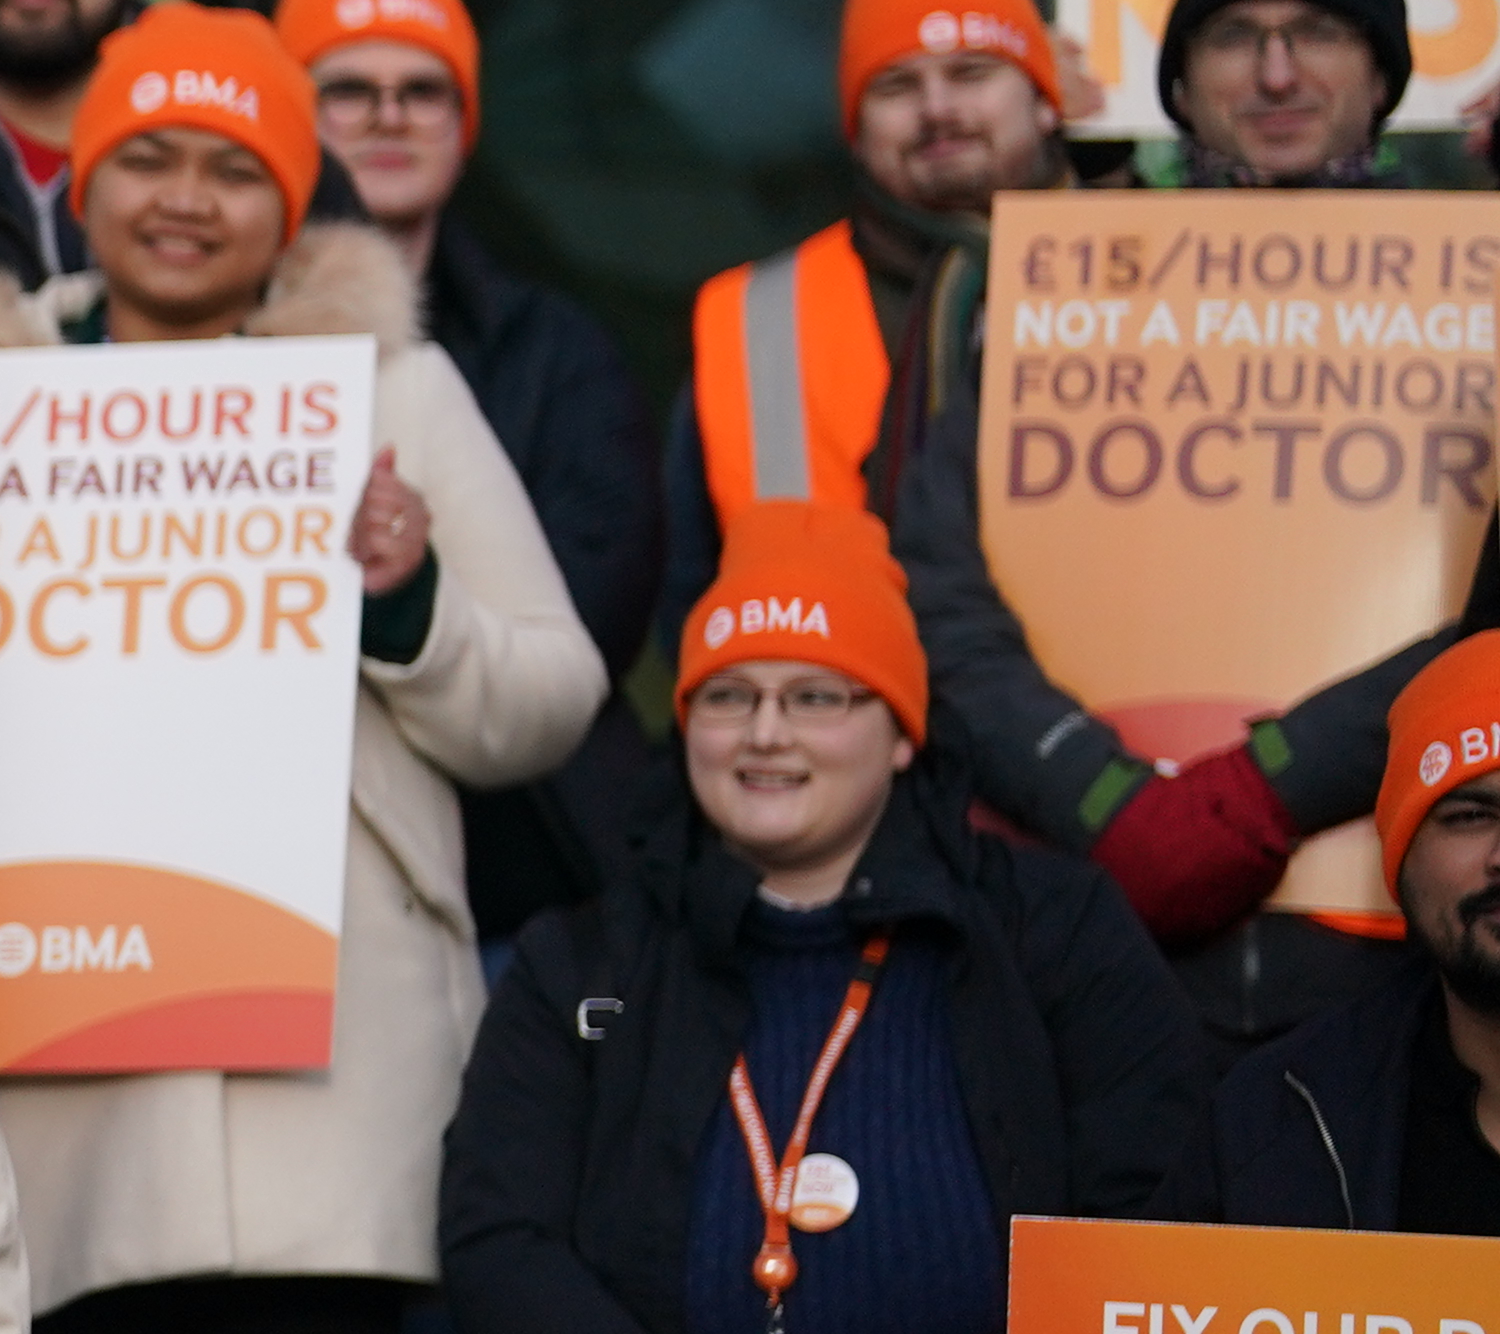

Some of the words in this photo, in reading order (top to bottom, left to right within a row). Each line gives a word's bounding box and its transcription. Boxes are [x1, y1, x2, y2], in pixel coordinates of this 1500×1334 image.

[174, 69, 259, 122] BMA
[1022, 229, 1414, 296] £15/HOUR
[1440, 233, 1500, 296] IS
[1013, 298, 1129, 351] NOT
[1141, 300, 1180, 351] A
[1195, 299, 1321, 350] FAIR
[1333, 300, 1495, 352] WAGE
[279, 381, 340, 437] IS
[1011, 354, 1146, 412] FOR
[1166, 357, 1209, 412] A
[1228, 355, 1496, 416] JUNIOR
[47, 455, 164, 498] FAIR
[182, 449, 337, 496] WAGE
[1007, 418, 1493, 510] DOCTOR
[17, 515, 62, 564] A
[77, 507, 333, 570] JUNIOR
[740, 596, 831, 640] BMA
[40, 922, 153, 974] BMA
